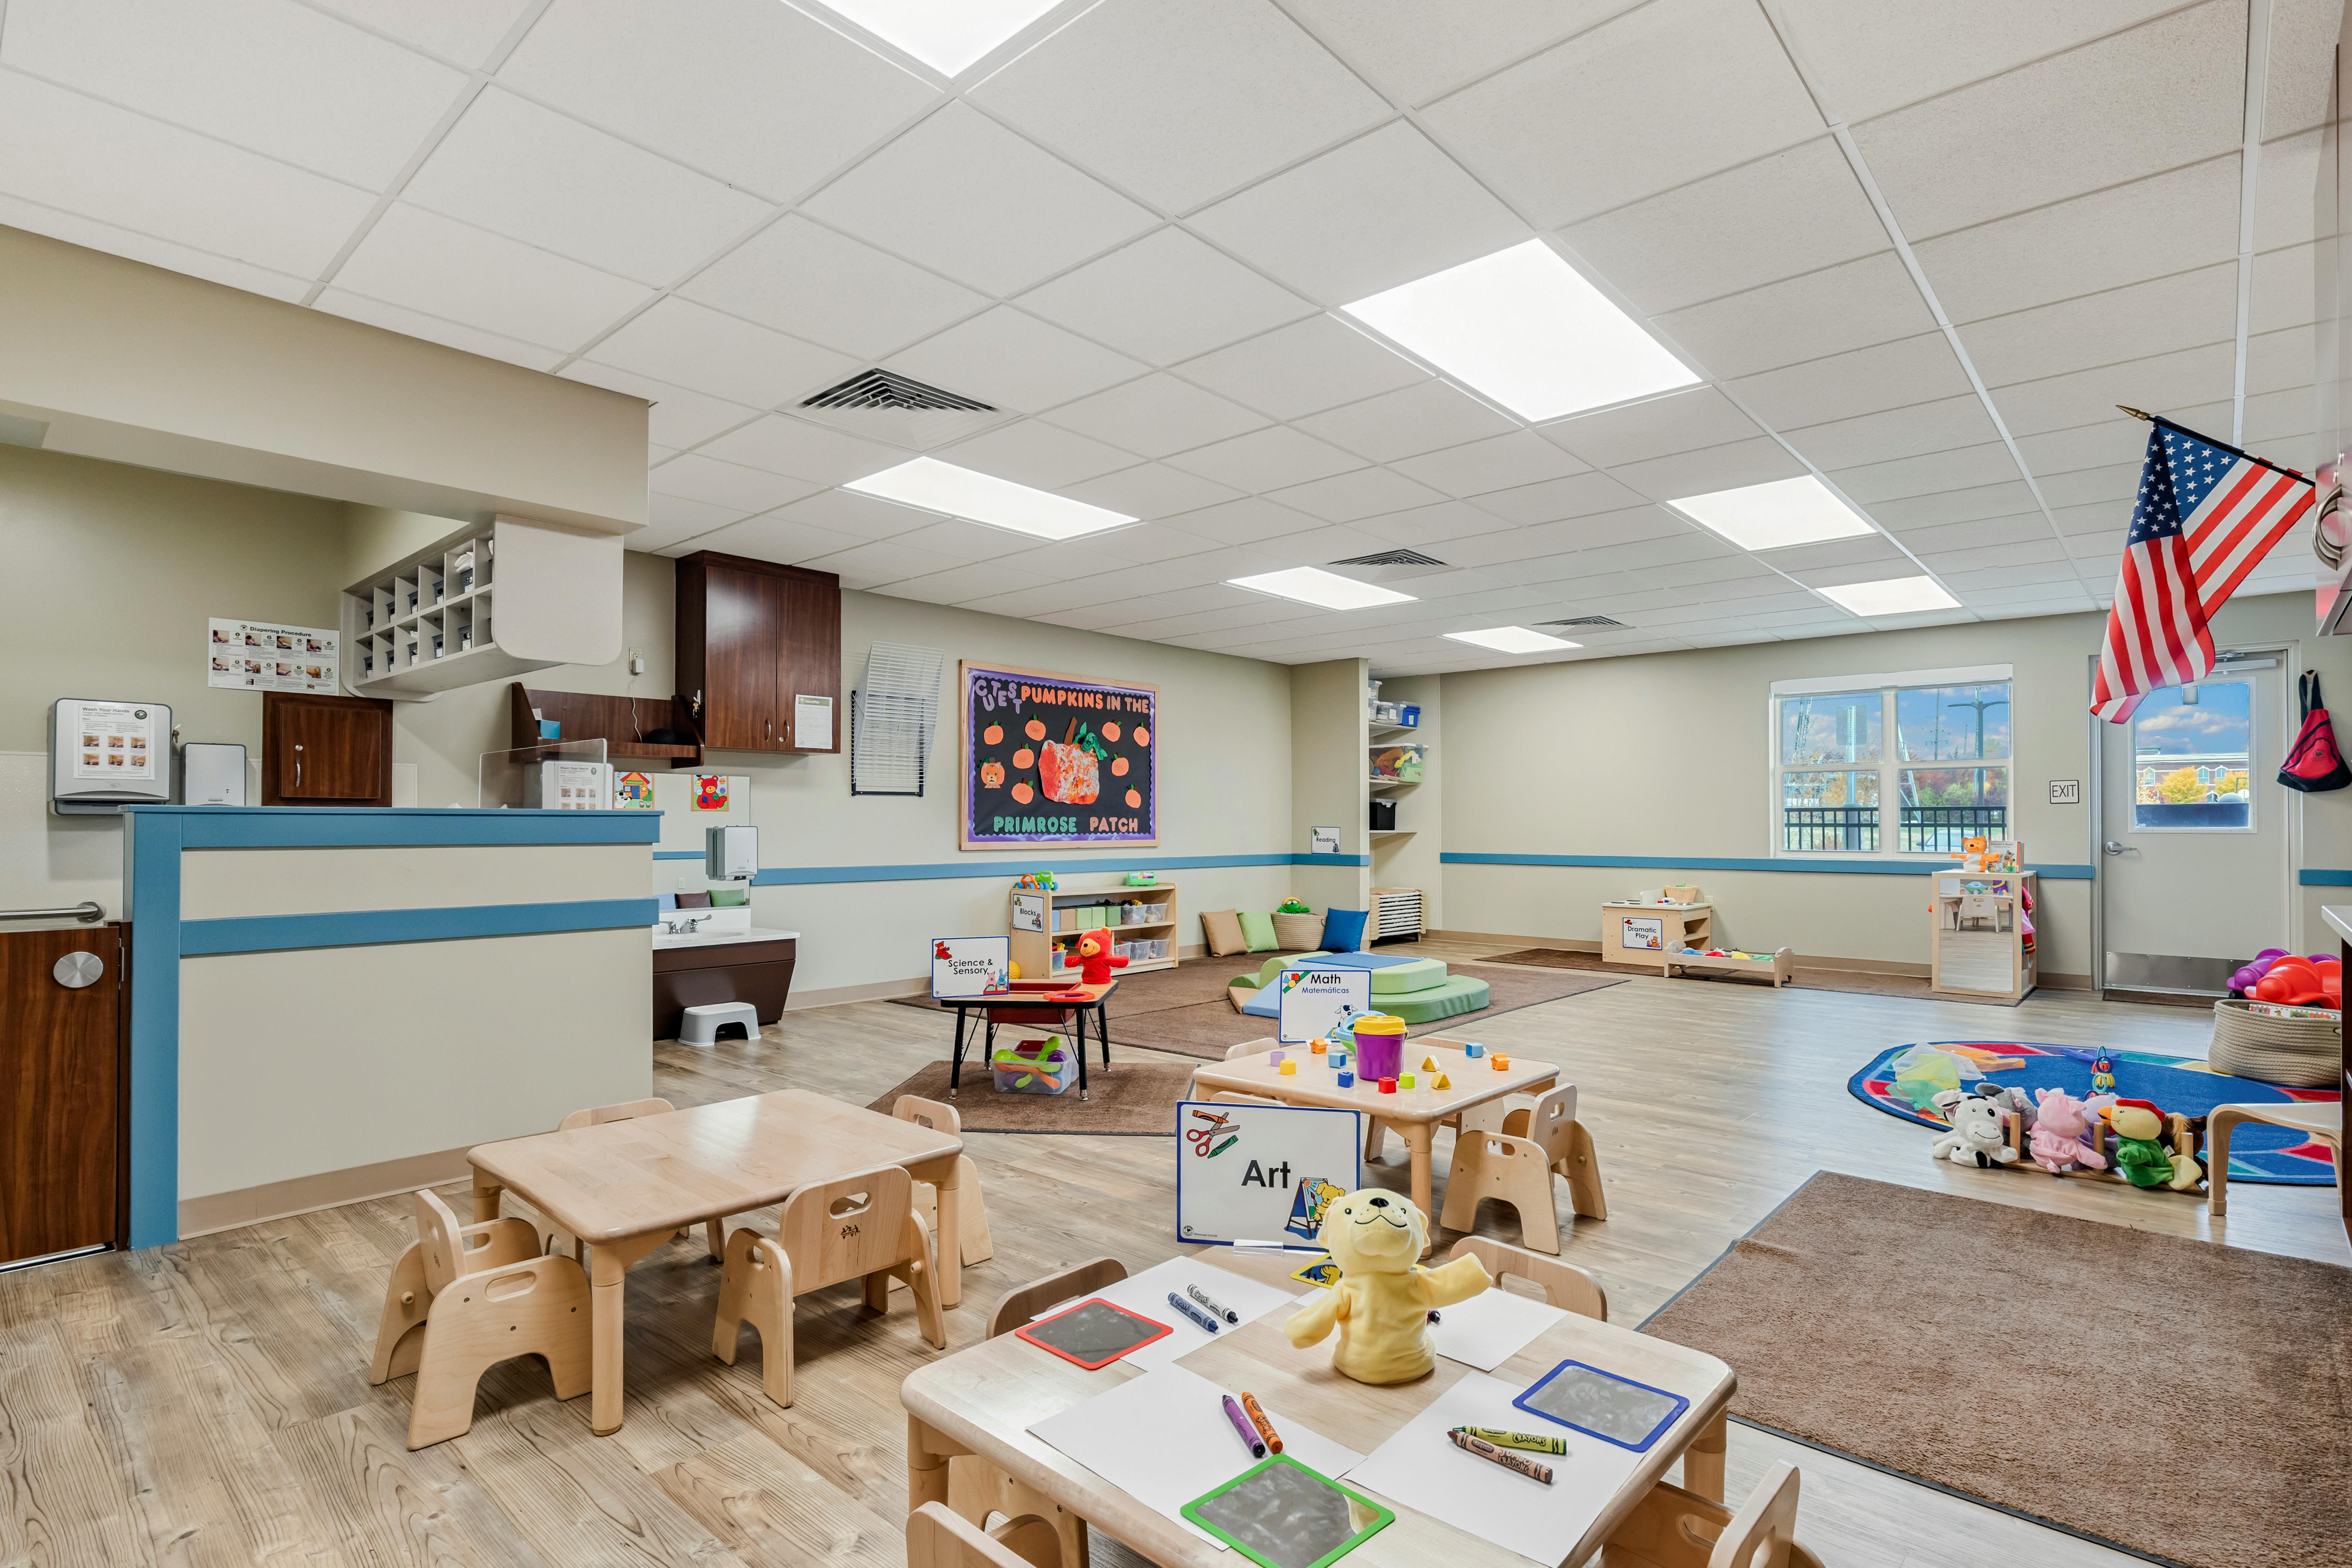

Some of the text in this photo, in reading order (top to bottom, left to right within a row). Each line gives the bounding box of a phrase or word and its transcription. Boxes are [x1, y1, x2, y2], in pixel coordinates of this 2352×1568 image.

[975, 679, 1149, 714] CUTEST PUMPKINS IN THE
[2052, 785, 2076, 797] EXIT
[994, 816, 1138, 833] PRIMROSE PATCH
[1310, 974, 1341, 984] Math
[1241, 1159, 1291, 1189] Art
[1256, 1415, 1271, 1434] CRAYONS
[1473, 1440, 1492, 1452] Crayola
[1513, 1433, 1547, 1446] CRAYONS
[1498, 1449, 1532, 1466] JUMBO
[1498, 1456, 1530, 1475] CRAYONS
